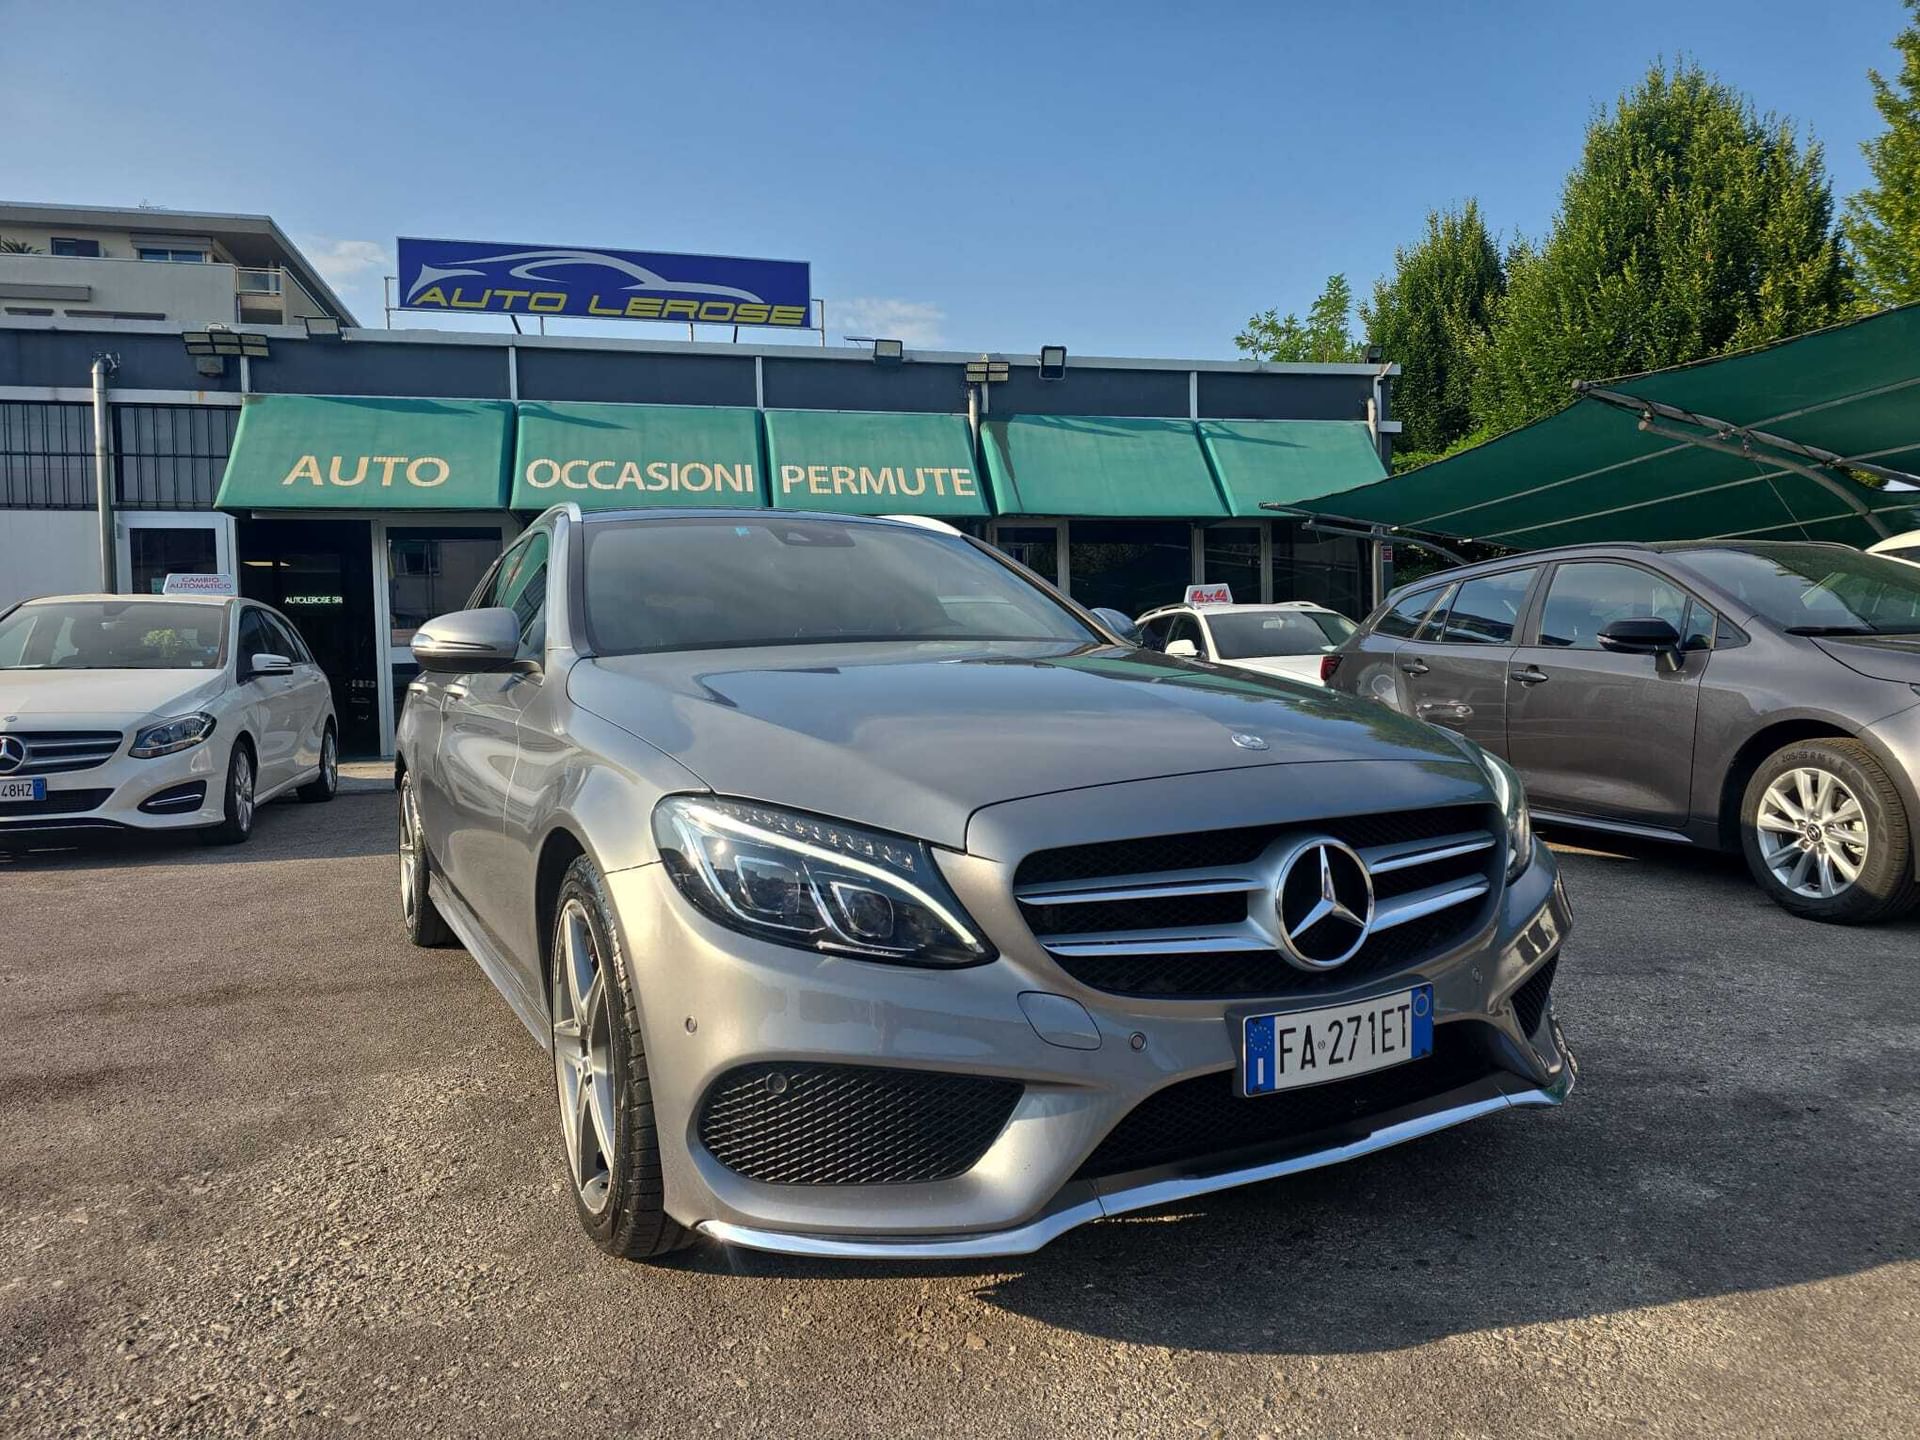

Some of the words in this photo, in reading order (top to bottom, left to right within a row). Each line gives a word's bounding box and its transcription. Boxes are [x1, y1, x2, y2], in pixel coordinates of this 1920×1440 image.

[412, 286, 567, 313] AUTO
[587, 294, 807, 325] LEROSE
[282, 455, 450, 487] AUTO
[526, 458, 754, 492] OCCASIONI
[780, 465, 976, 496] PERMUTE
